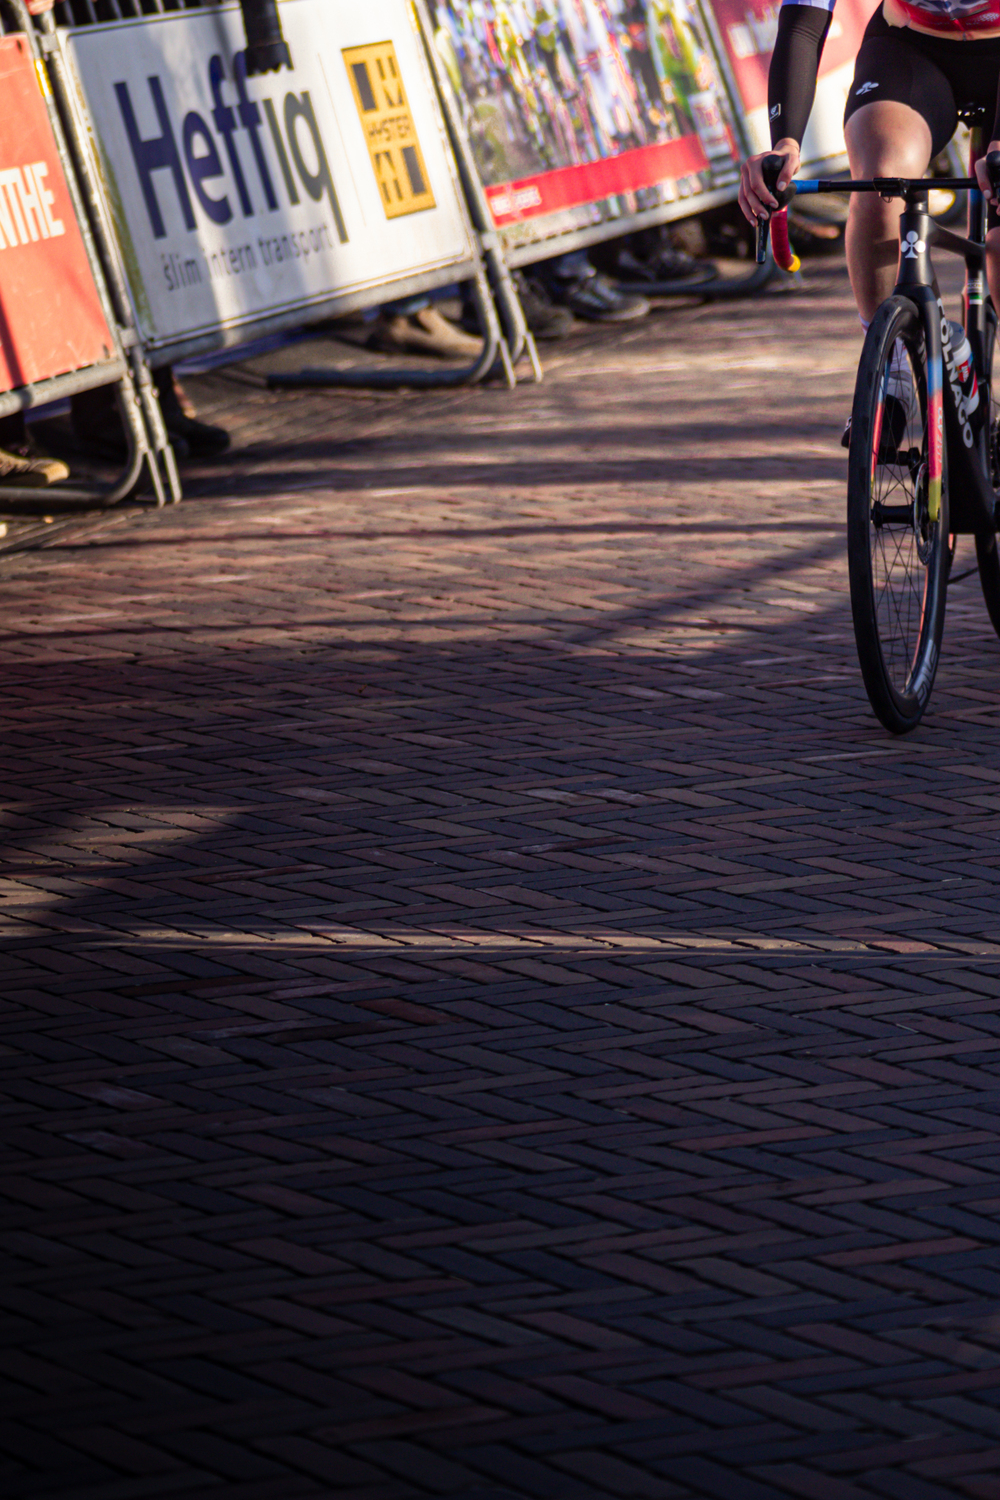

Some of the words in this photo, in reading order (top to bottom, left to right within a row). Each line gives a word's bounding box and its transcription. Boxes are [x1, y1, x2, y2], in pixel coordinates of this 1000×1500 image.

[113, 51, 350, 244] Heffiq
[203, 244, 259, 280] intern
[258, 222, 335, 268] transport
